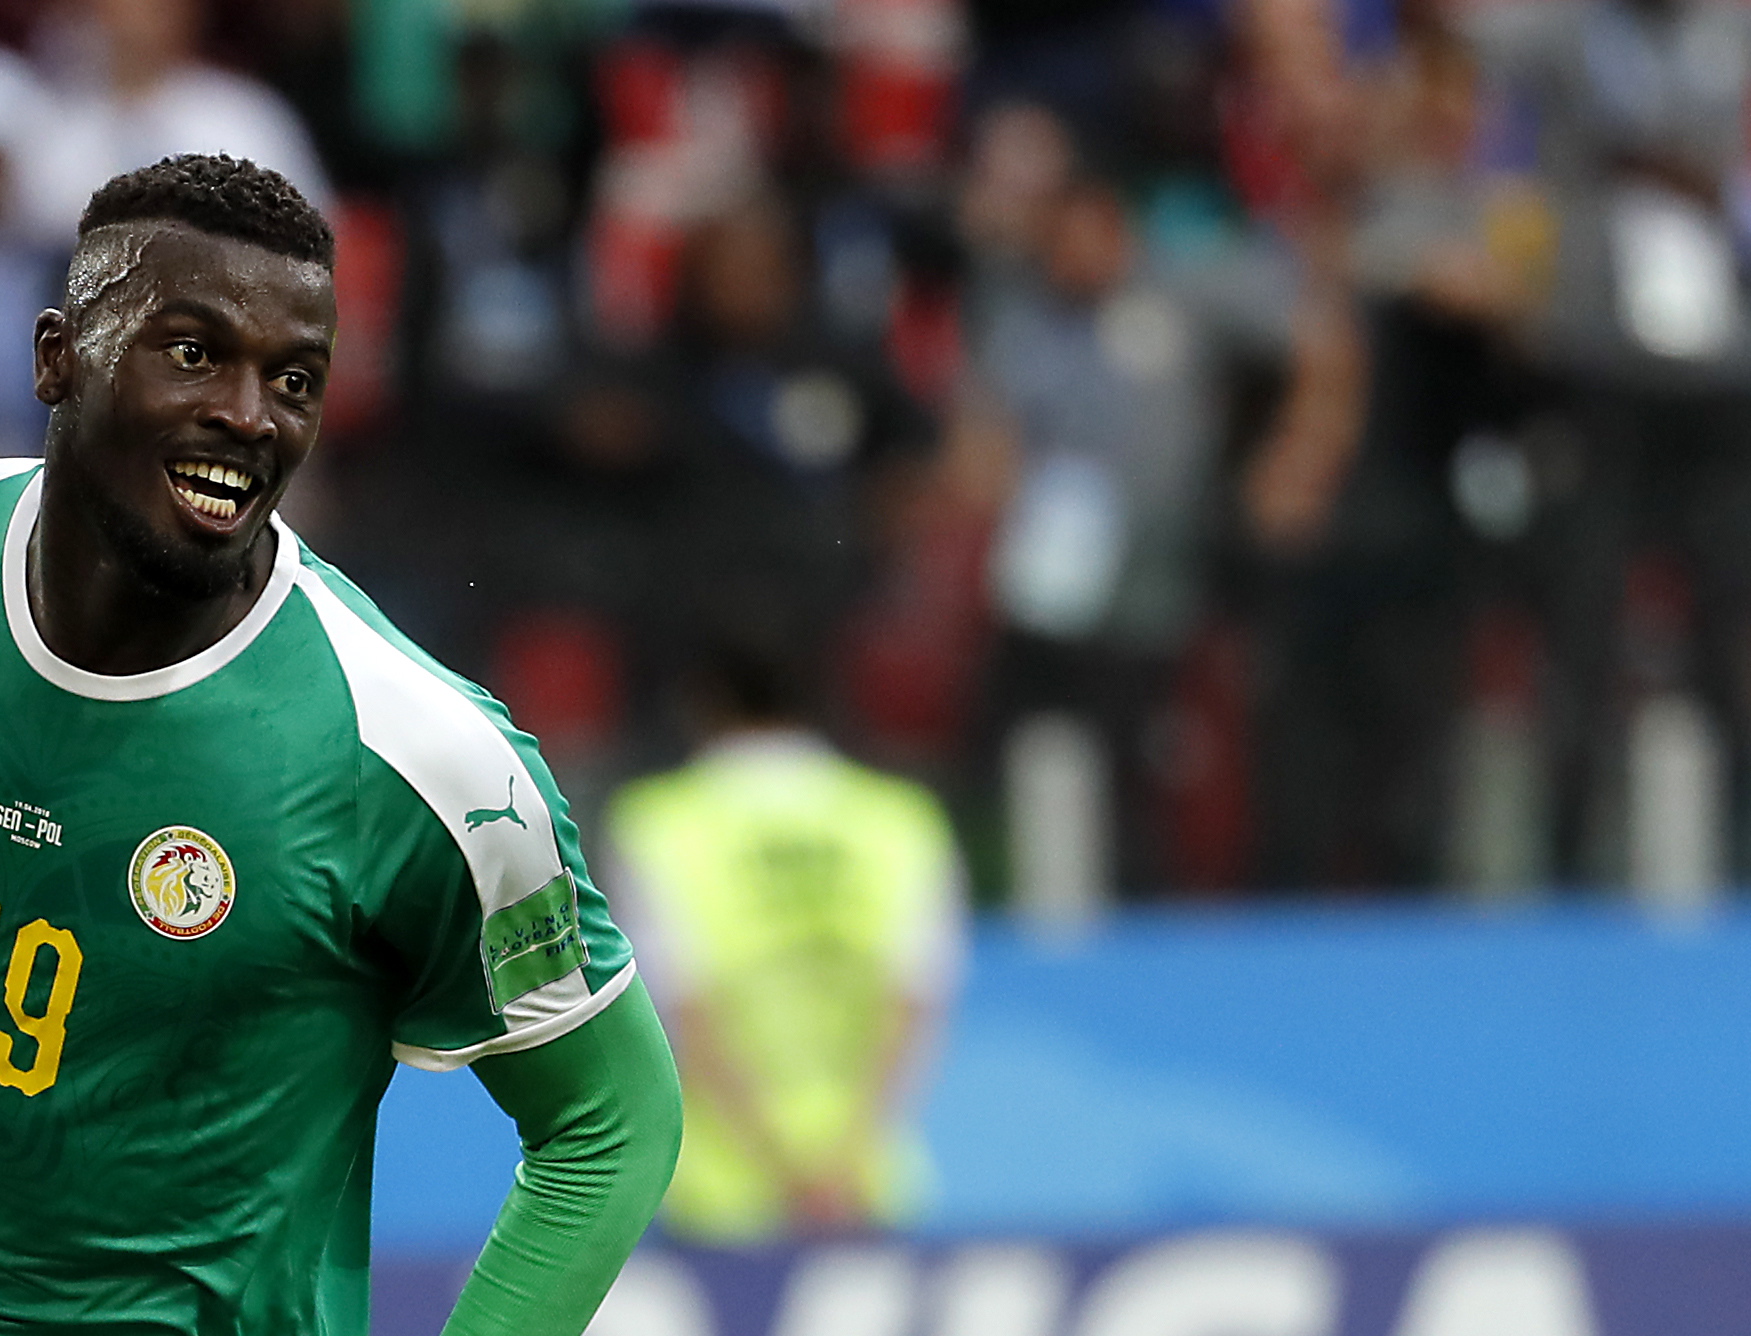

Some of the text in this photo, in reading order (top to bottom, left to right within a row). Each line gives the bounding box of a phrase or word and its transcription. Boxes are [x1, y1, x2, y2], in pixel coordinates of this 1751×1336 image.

[35, 817, 63, 847] POL
[157, 919, 214, 935] FOOTBALL
[489, 903, 568, 953] LIVING
[491, 914, 570, 962] FOOTBALL
[546, 934, 574, 957] FIFA
